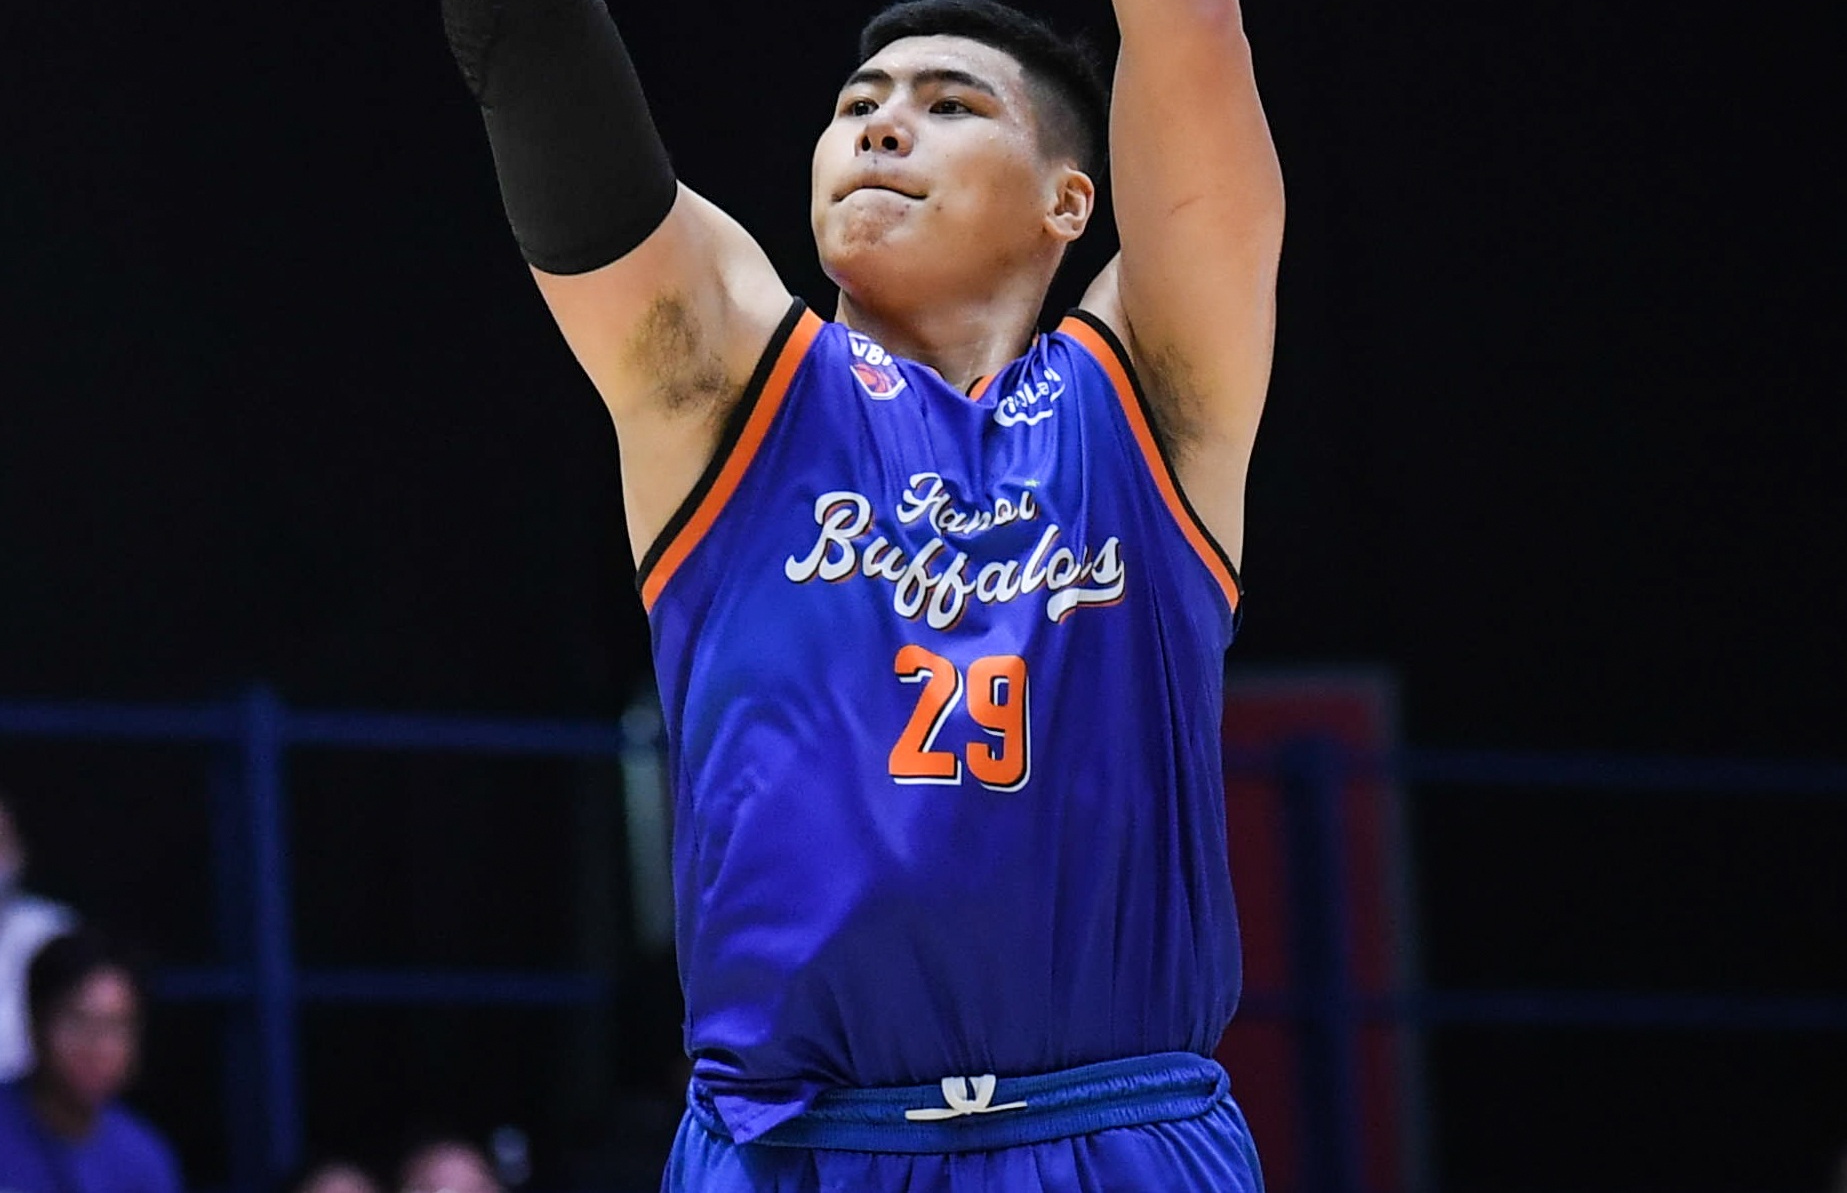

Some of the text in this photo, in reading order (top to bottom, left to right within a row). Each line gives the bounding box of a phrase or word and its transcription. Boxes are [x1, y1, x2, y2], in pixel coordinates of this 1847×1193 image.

[785, 491, 1125, 630] Buffalos
[896, 472, 1039, 535] Hanoi
[888, 644, 1032, 792] 29
